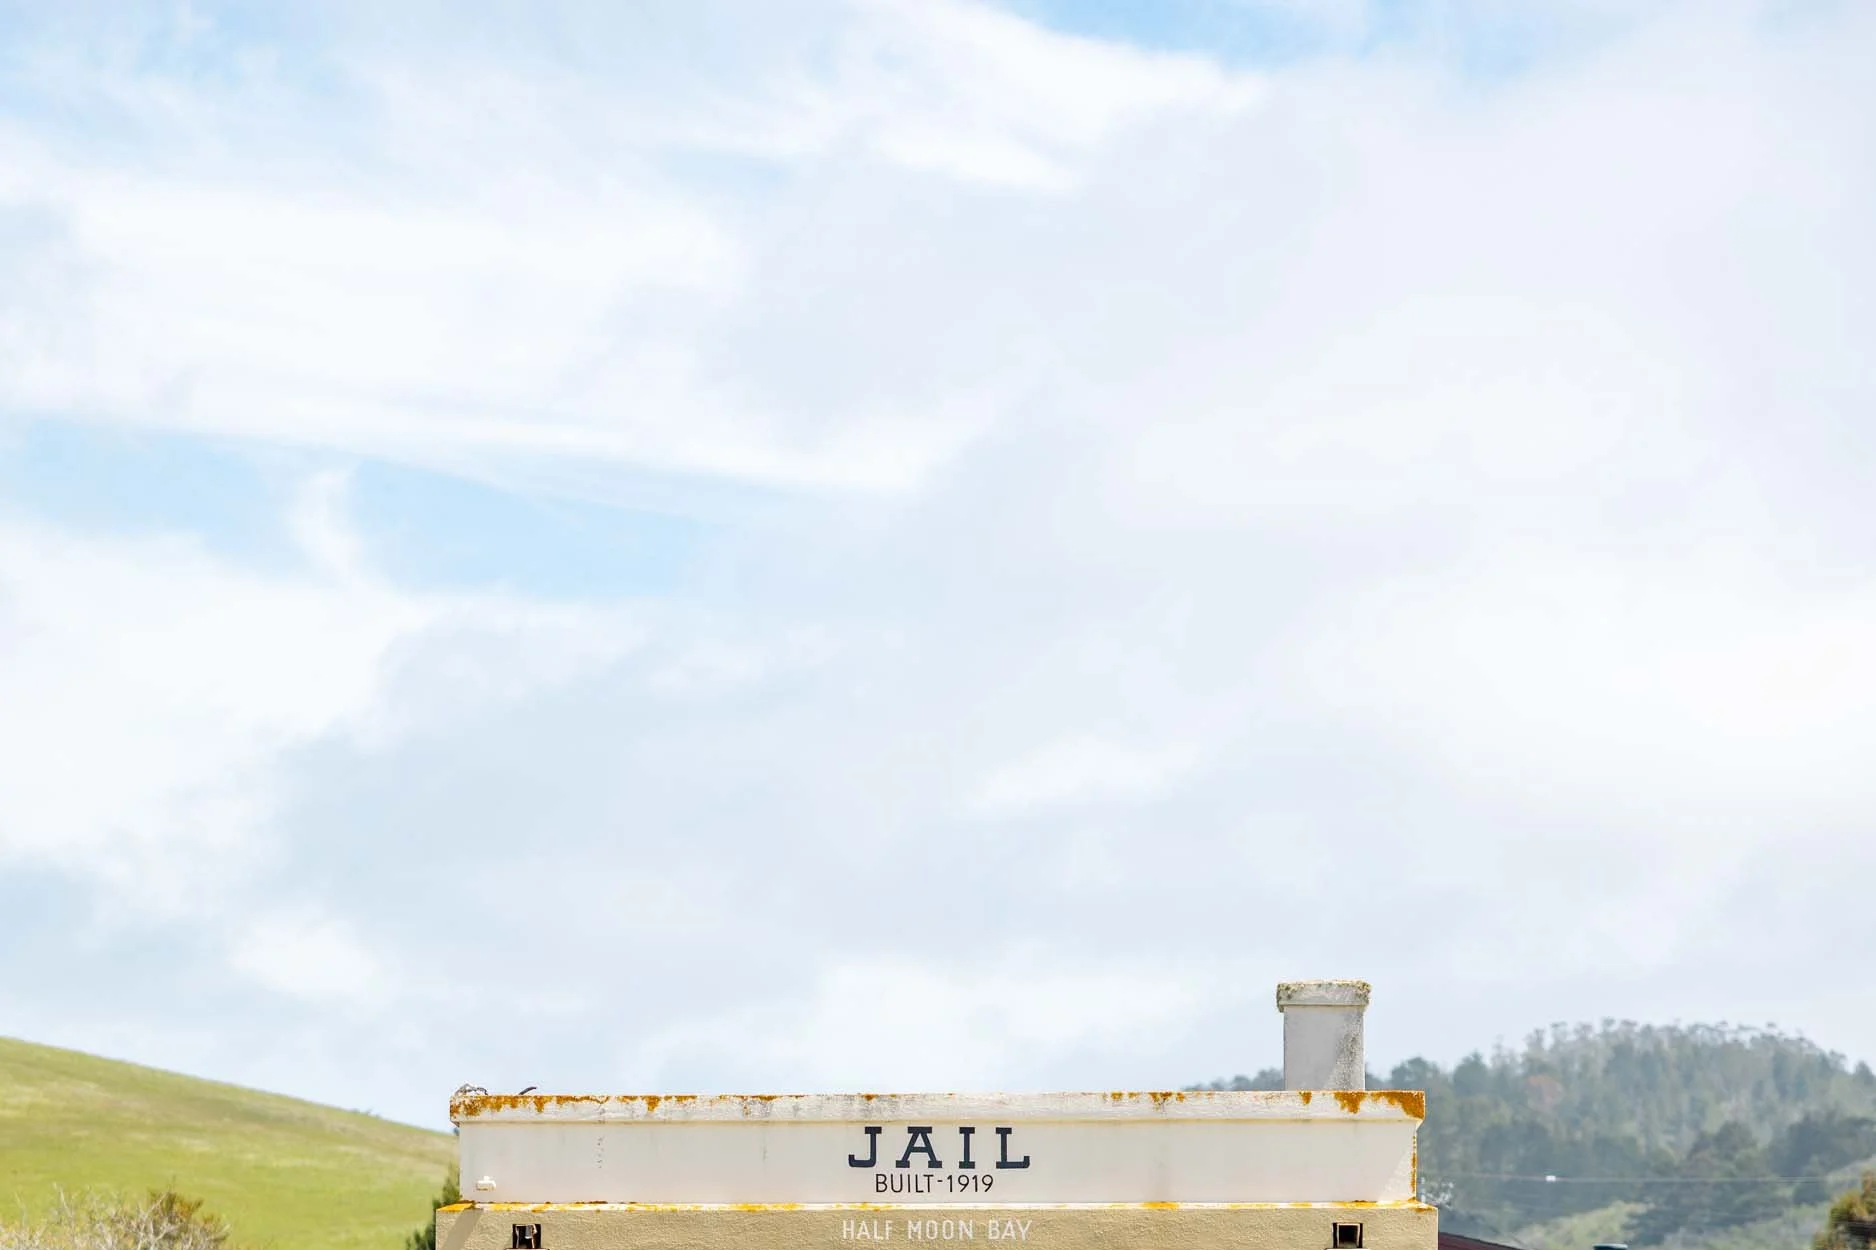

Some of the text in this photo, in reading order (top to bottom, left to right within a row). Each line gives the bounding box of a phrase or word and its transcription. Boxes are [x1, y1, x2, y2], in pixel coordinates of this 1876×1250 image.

[848, 1126, 1031, 1169] JAIL
[875, 1173, 994, 1193] BUILT-1919
[842, 1219, 1032, 1240] HALF MOON BAY
